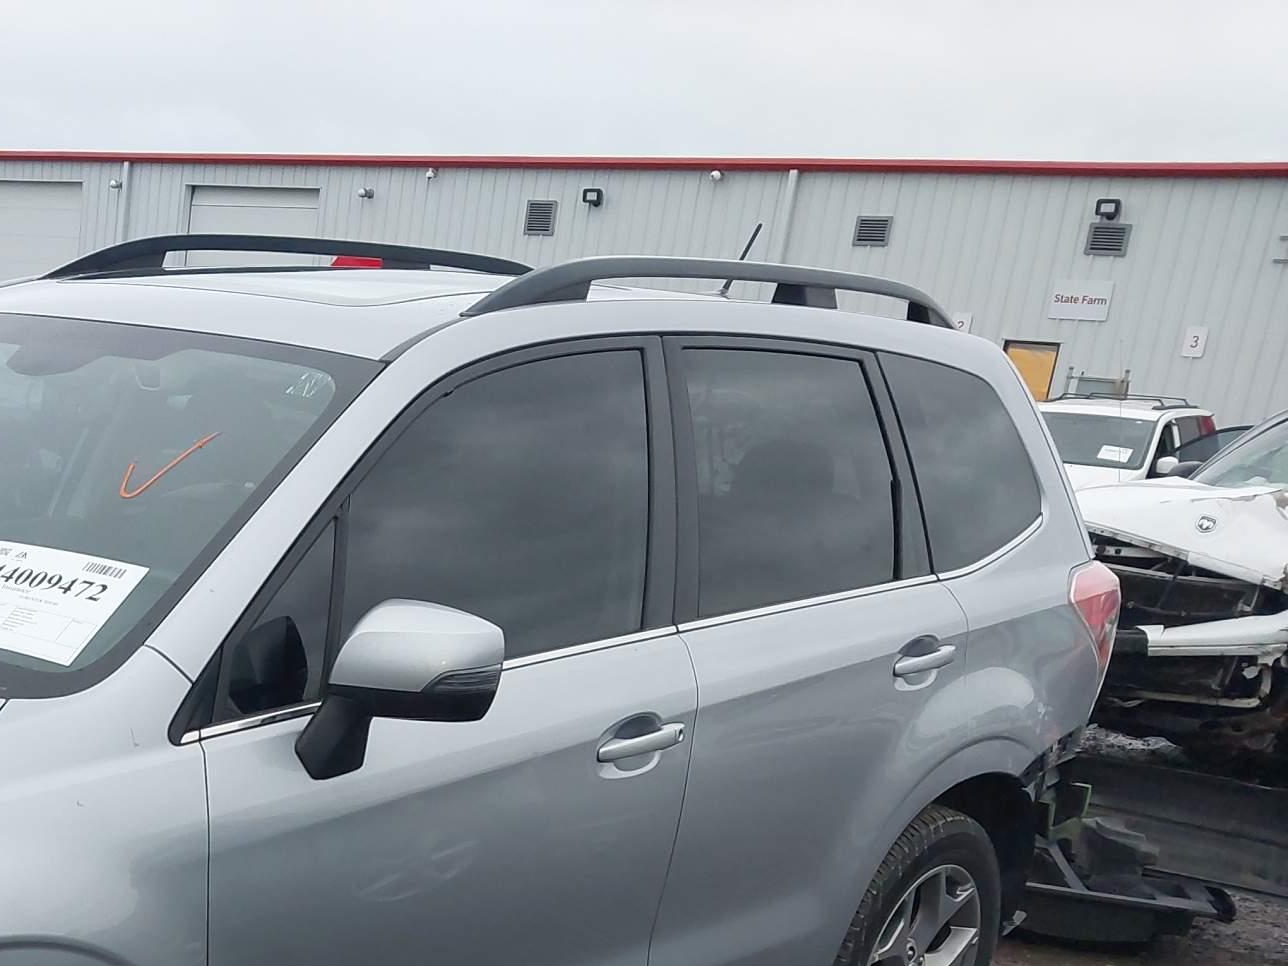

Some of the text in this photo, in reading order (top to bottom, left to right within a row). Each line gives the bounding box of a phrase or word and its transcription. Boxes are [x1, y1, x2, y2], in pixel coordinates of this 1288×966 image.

[1054, 293, 1108, 305] State Farm
[1190, 335, 1200, 349] 3
